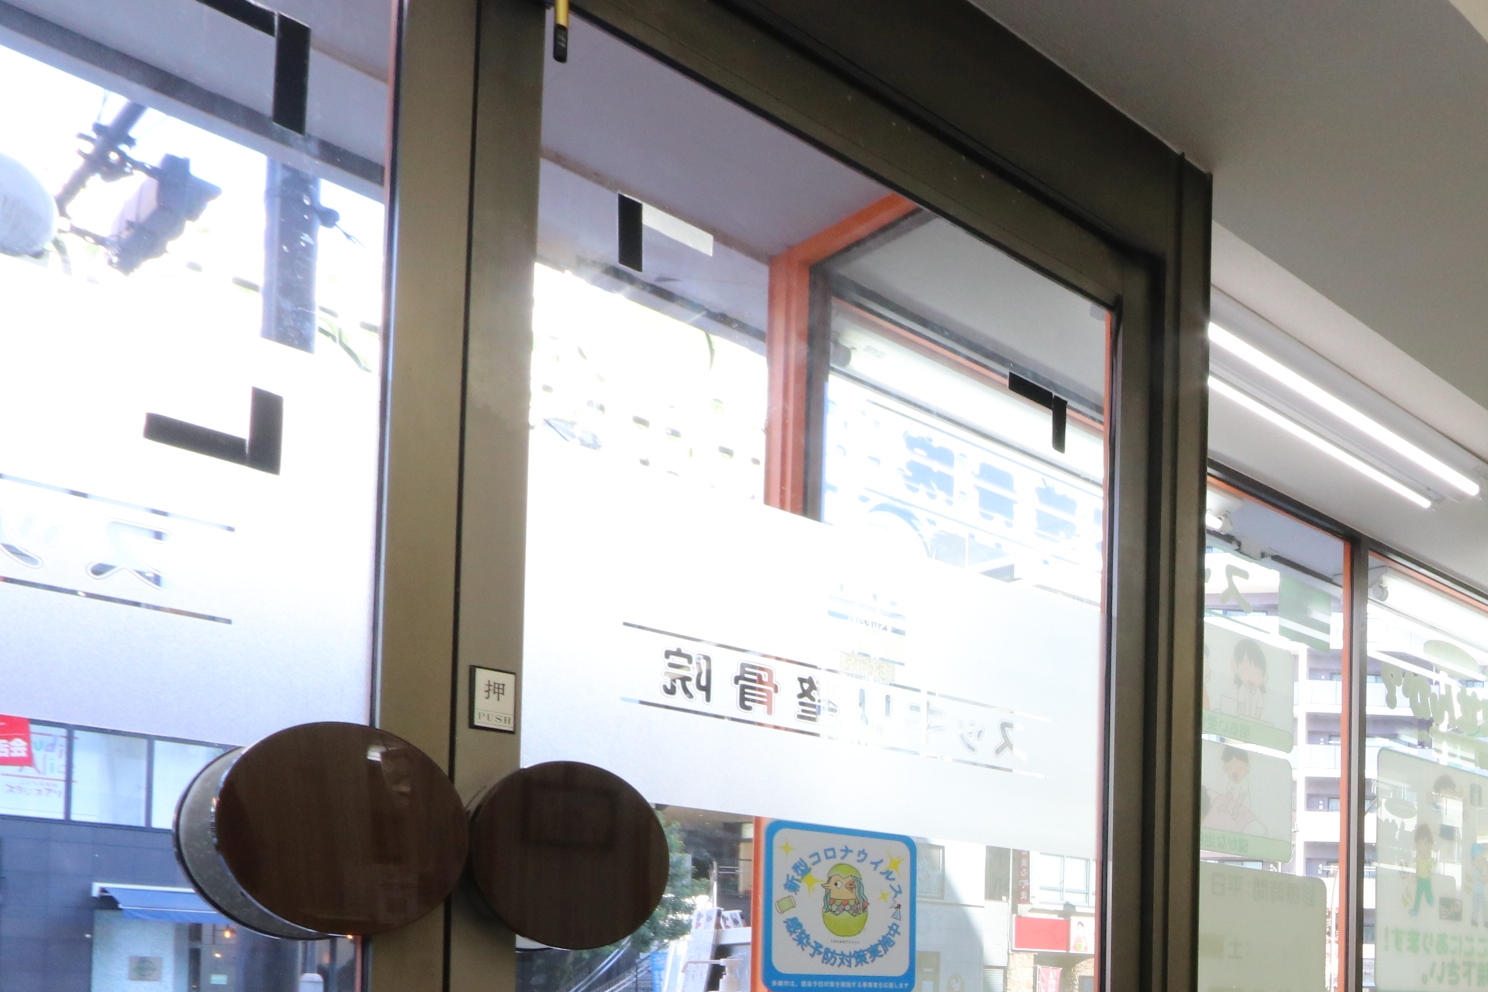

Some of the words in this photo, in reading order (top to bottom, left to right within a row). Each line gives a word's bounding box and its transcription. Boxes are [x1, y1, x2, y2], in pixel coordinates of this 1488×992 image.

[484, 680, 505, 701] 押
[478, 712, 511, 725] PUSH
[783, 916, 901, 968] 感染予防対策実施中
